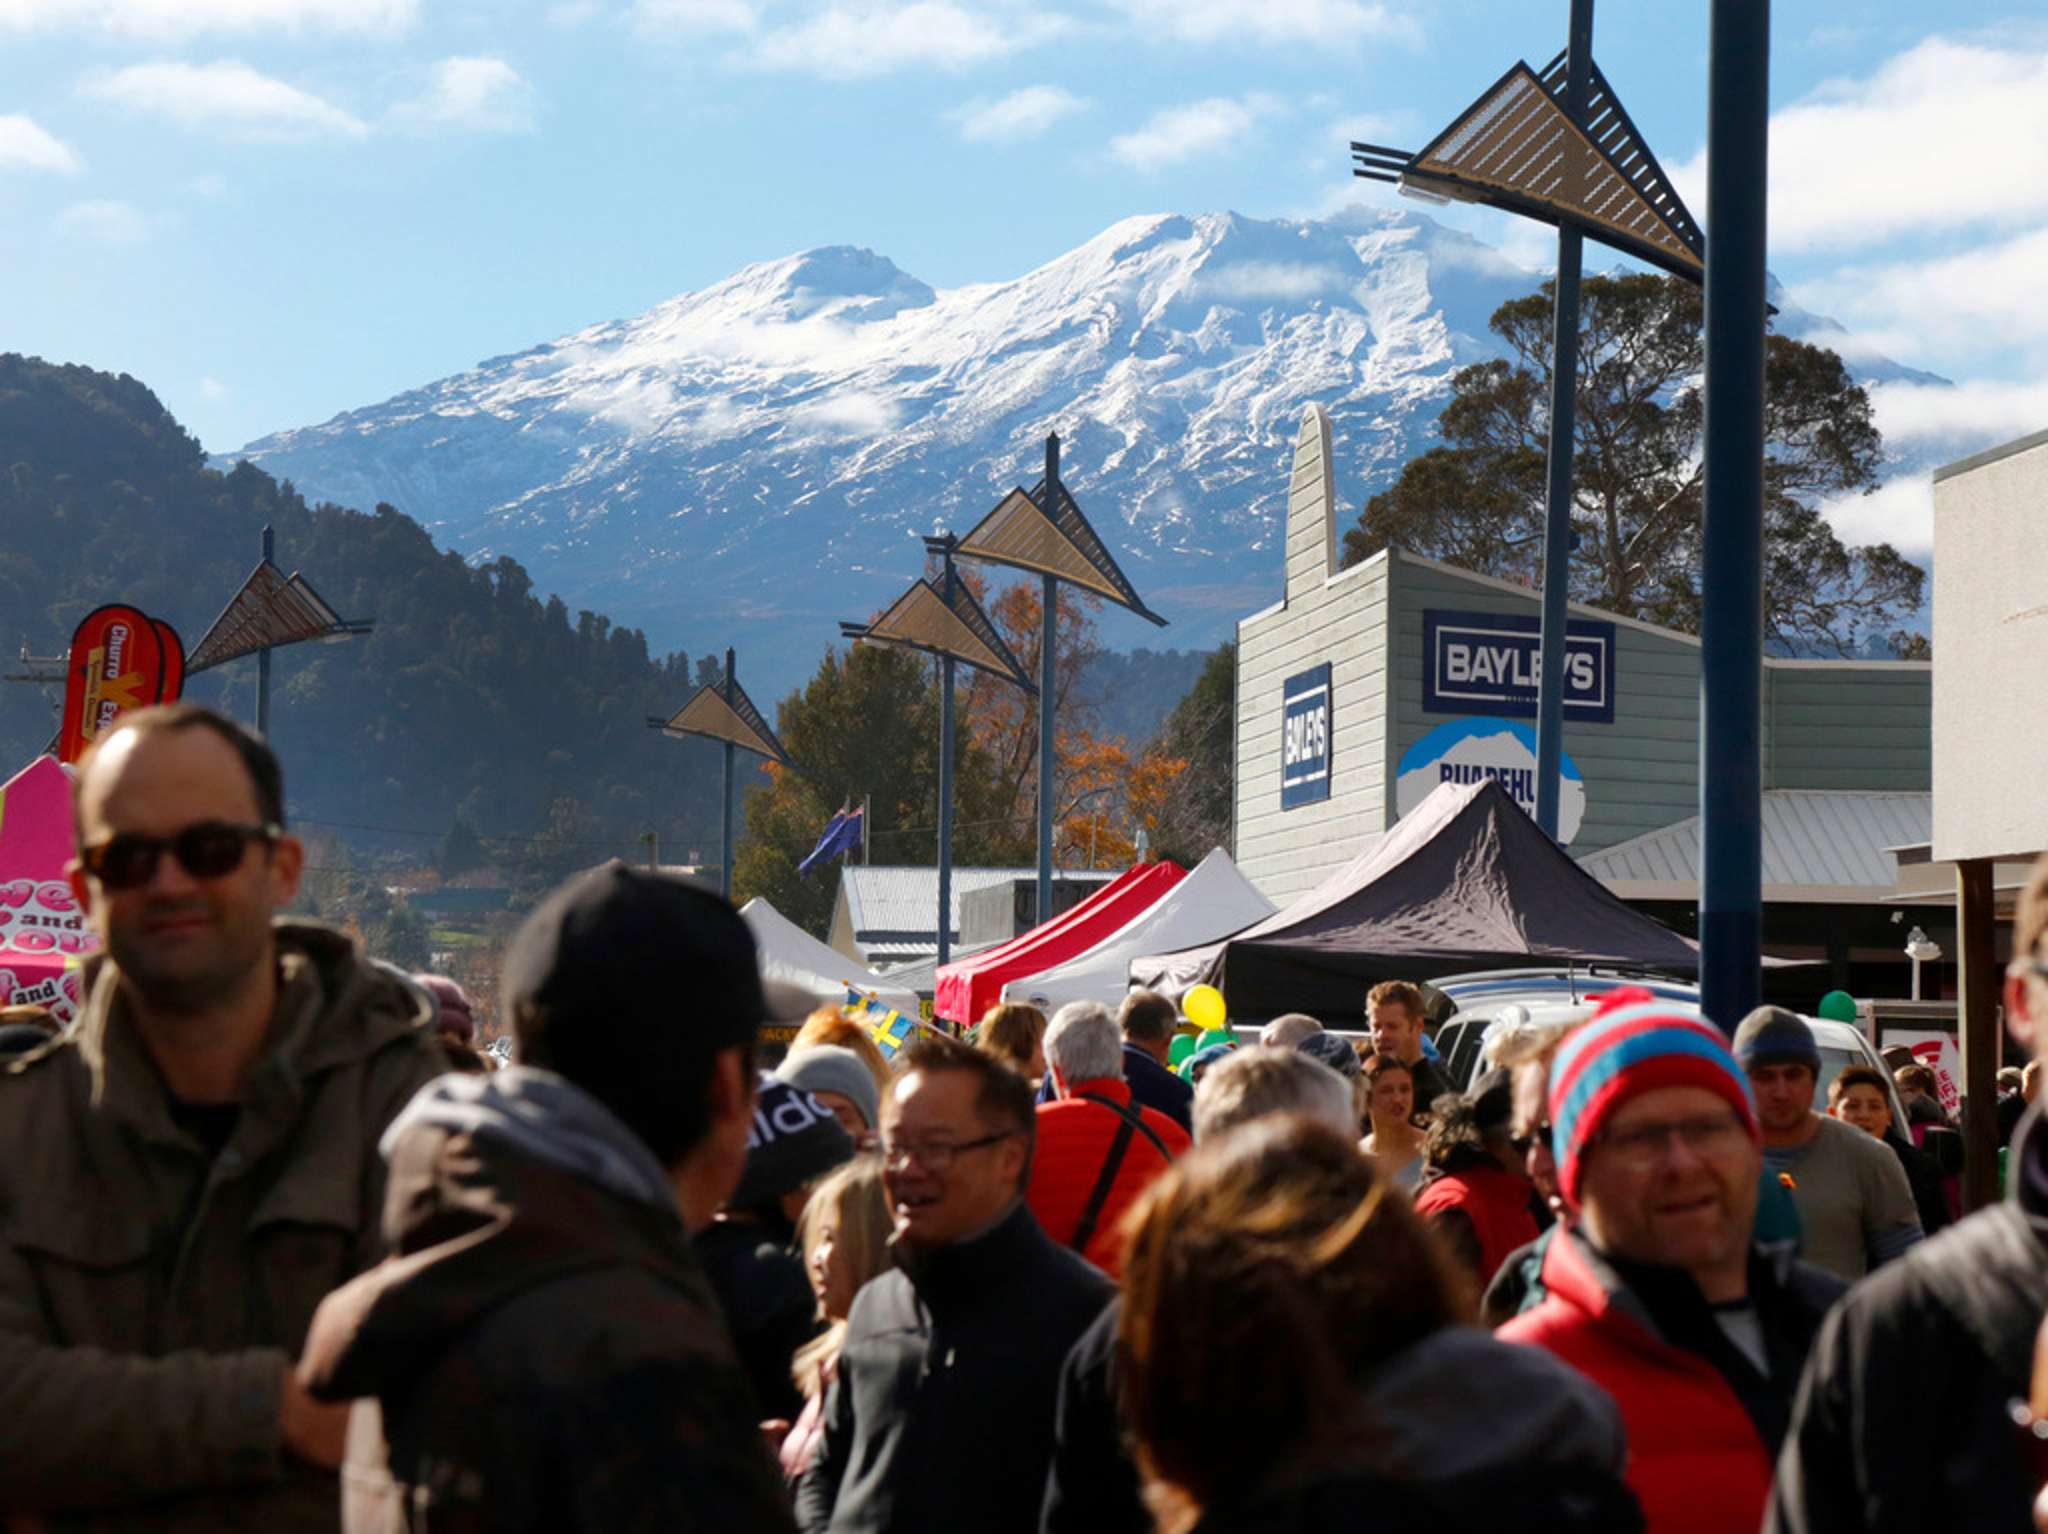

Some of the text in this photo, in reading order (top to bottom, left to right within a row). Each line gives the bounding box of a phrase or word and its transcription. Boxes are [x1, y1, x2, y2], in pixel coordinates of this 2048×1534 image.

[106, 624, 128, 679] Churro
[1286, 705, 1326, 766] BAYLEYS
[20, 914, 83, 931] and
[15, 980, 56, 1005] and
